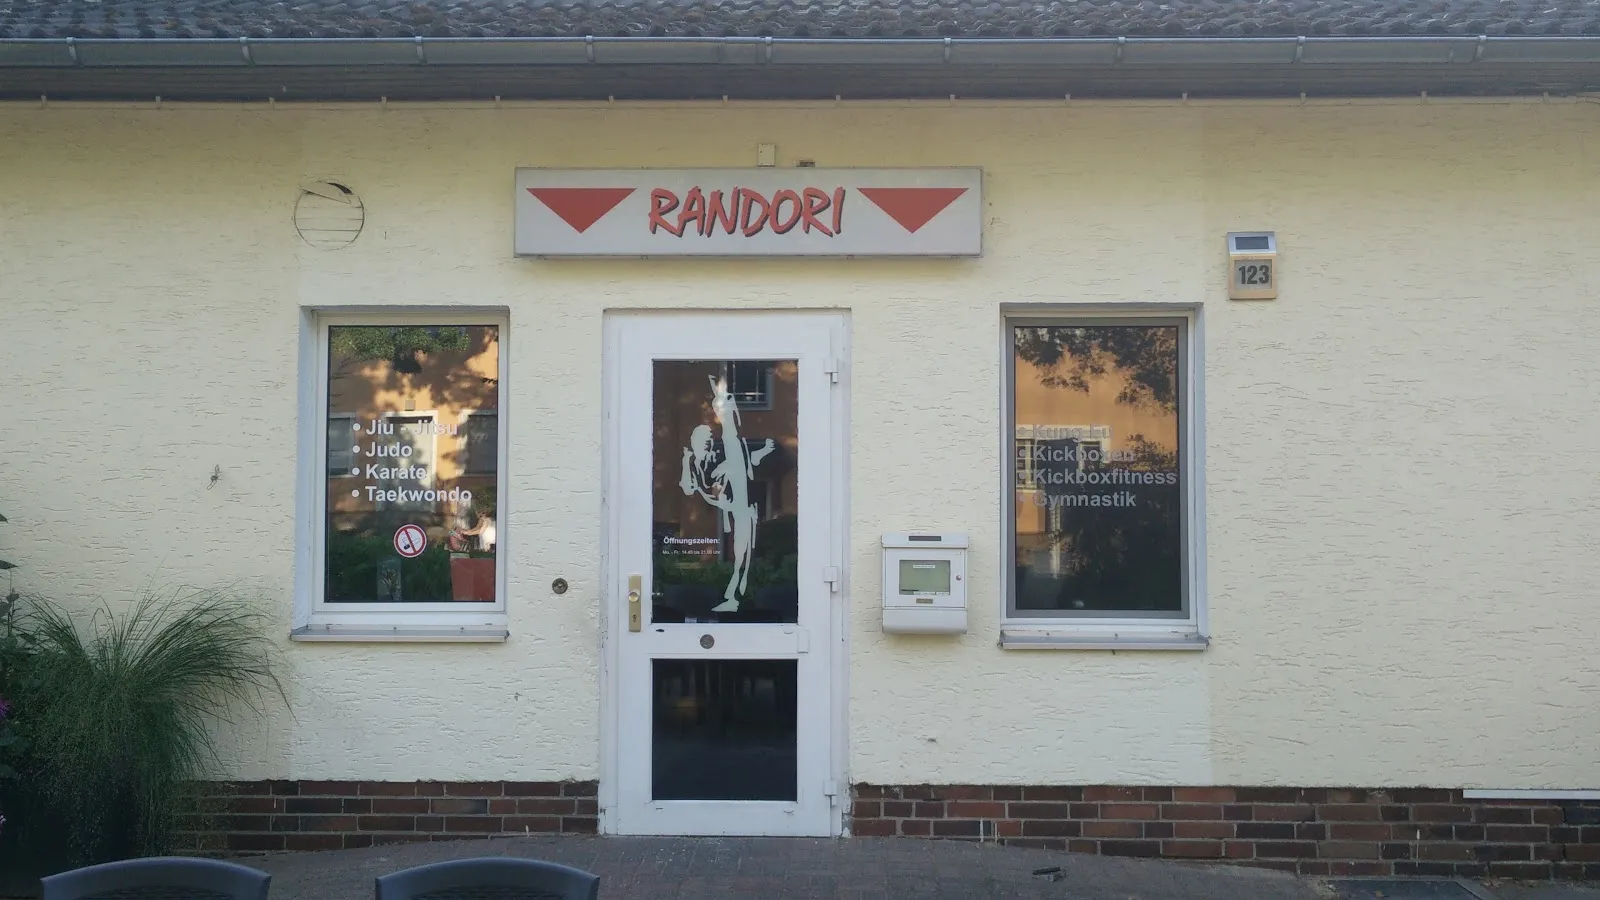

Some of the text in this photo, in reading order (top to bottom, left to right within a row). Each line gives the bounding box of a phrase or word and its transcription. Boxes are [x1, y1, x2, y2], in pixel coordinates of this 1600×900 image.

[648, 185, 846, 238] RANDORI
[1238, 264, 1270, 285] 123
[365, 419, 394, 436] Jiu
[414, 419, 458, 436] Jitsu
[1033, 424, 1082, 443] Kung
[365, 441, 413, 458] Judo
[1033, 445, 1134, 462] Kickboxen
[365, 463, 428, 480] Karate
[1033, 467, 1177, 485] Kickboxfitness
[365, 485, 472, 503] Taekwondo
[1032, 490, 1137, 510] Gymnastik
[663, 536, 721, 546] Öffnungszeiten:
